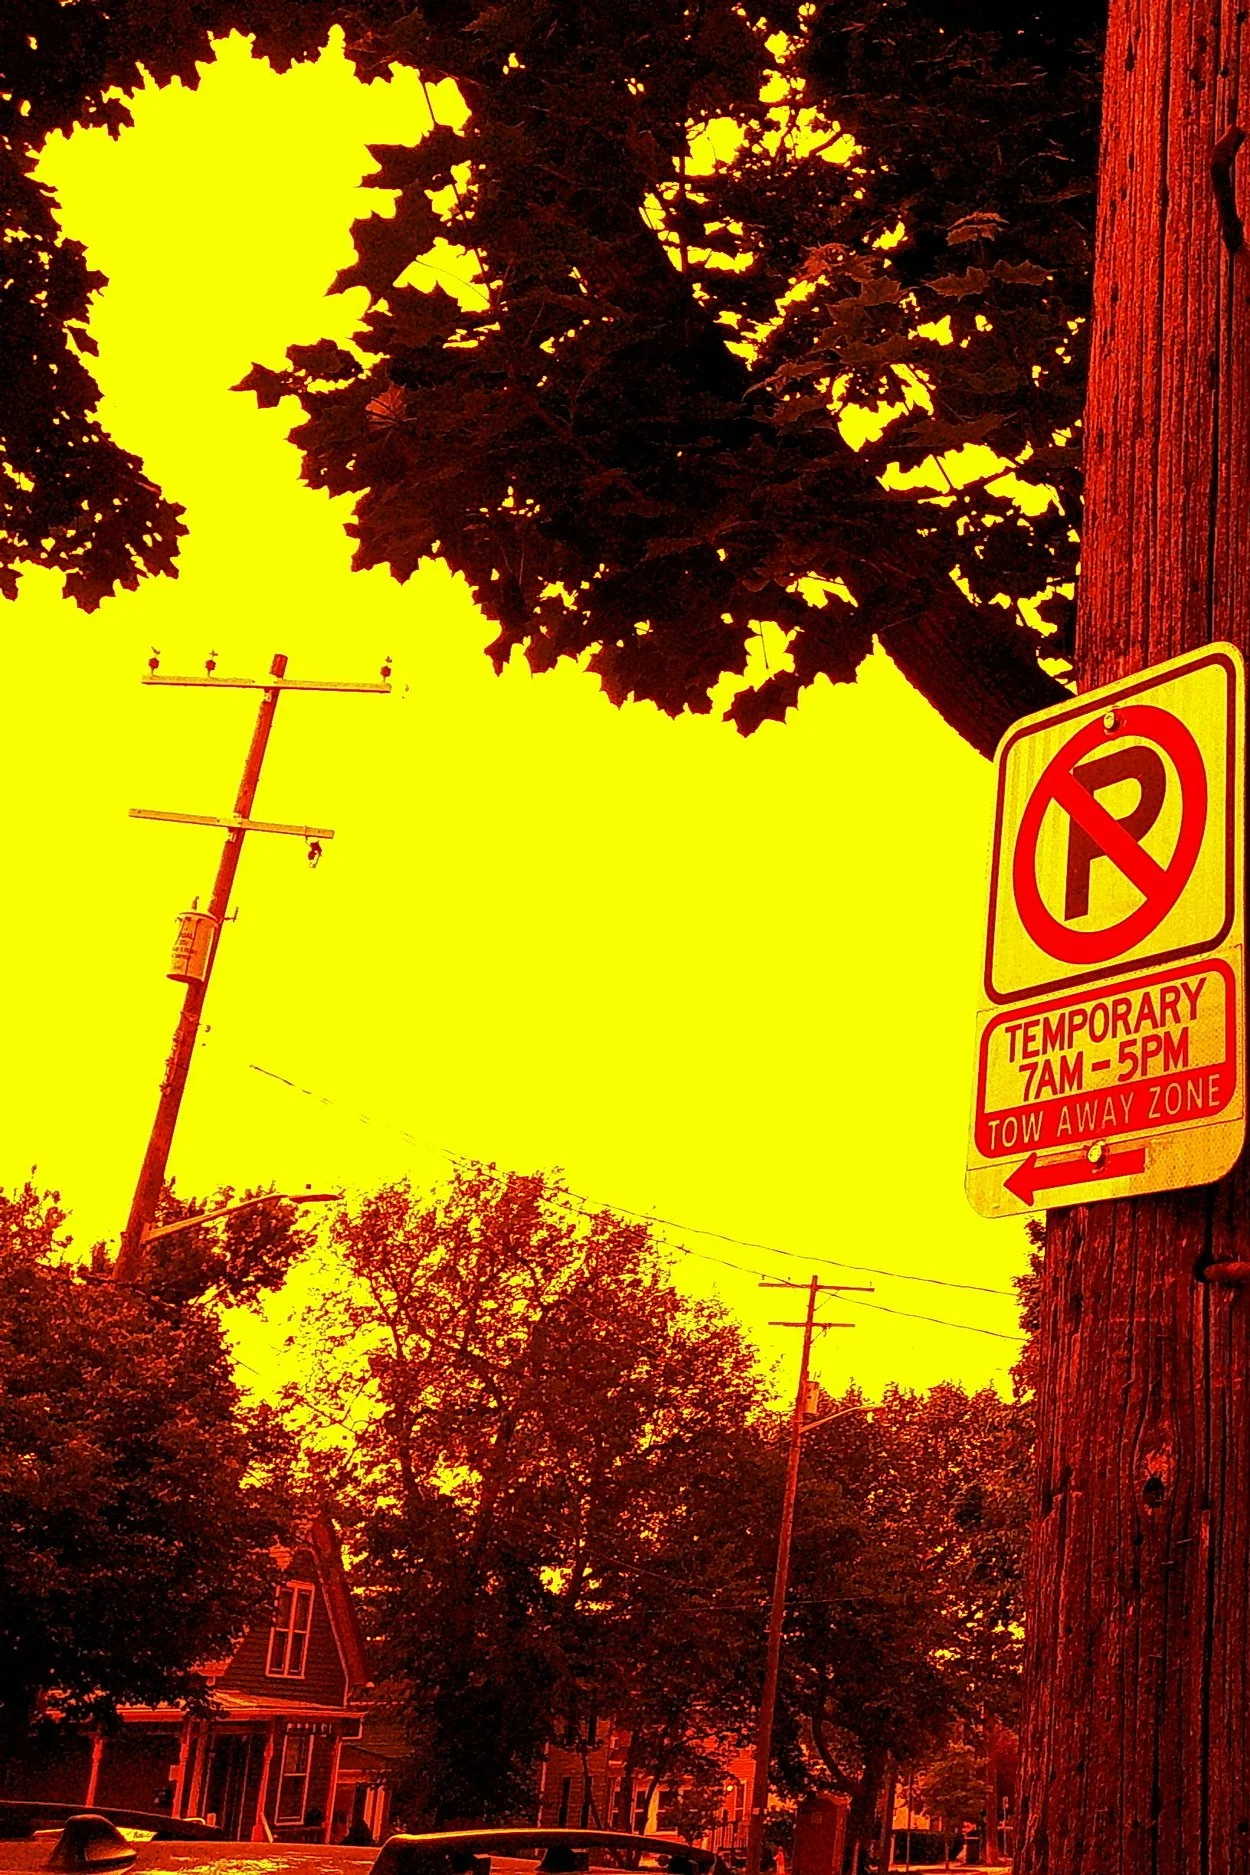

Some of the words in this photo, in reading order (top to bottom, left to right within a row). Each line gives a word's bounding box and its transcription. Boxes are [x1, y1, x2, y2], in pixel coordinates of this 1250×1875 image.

[1064, 745, 1167, 922] P
[1004, 977, 1207, 1063] TEMPORARY
[987, 1110, 1045, 1150] TOW
[1056, 1091, 1135, 1138] AWAY
[1148, 1073, 1221, 1119] ZONE
